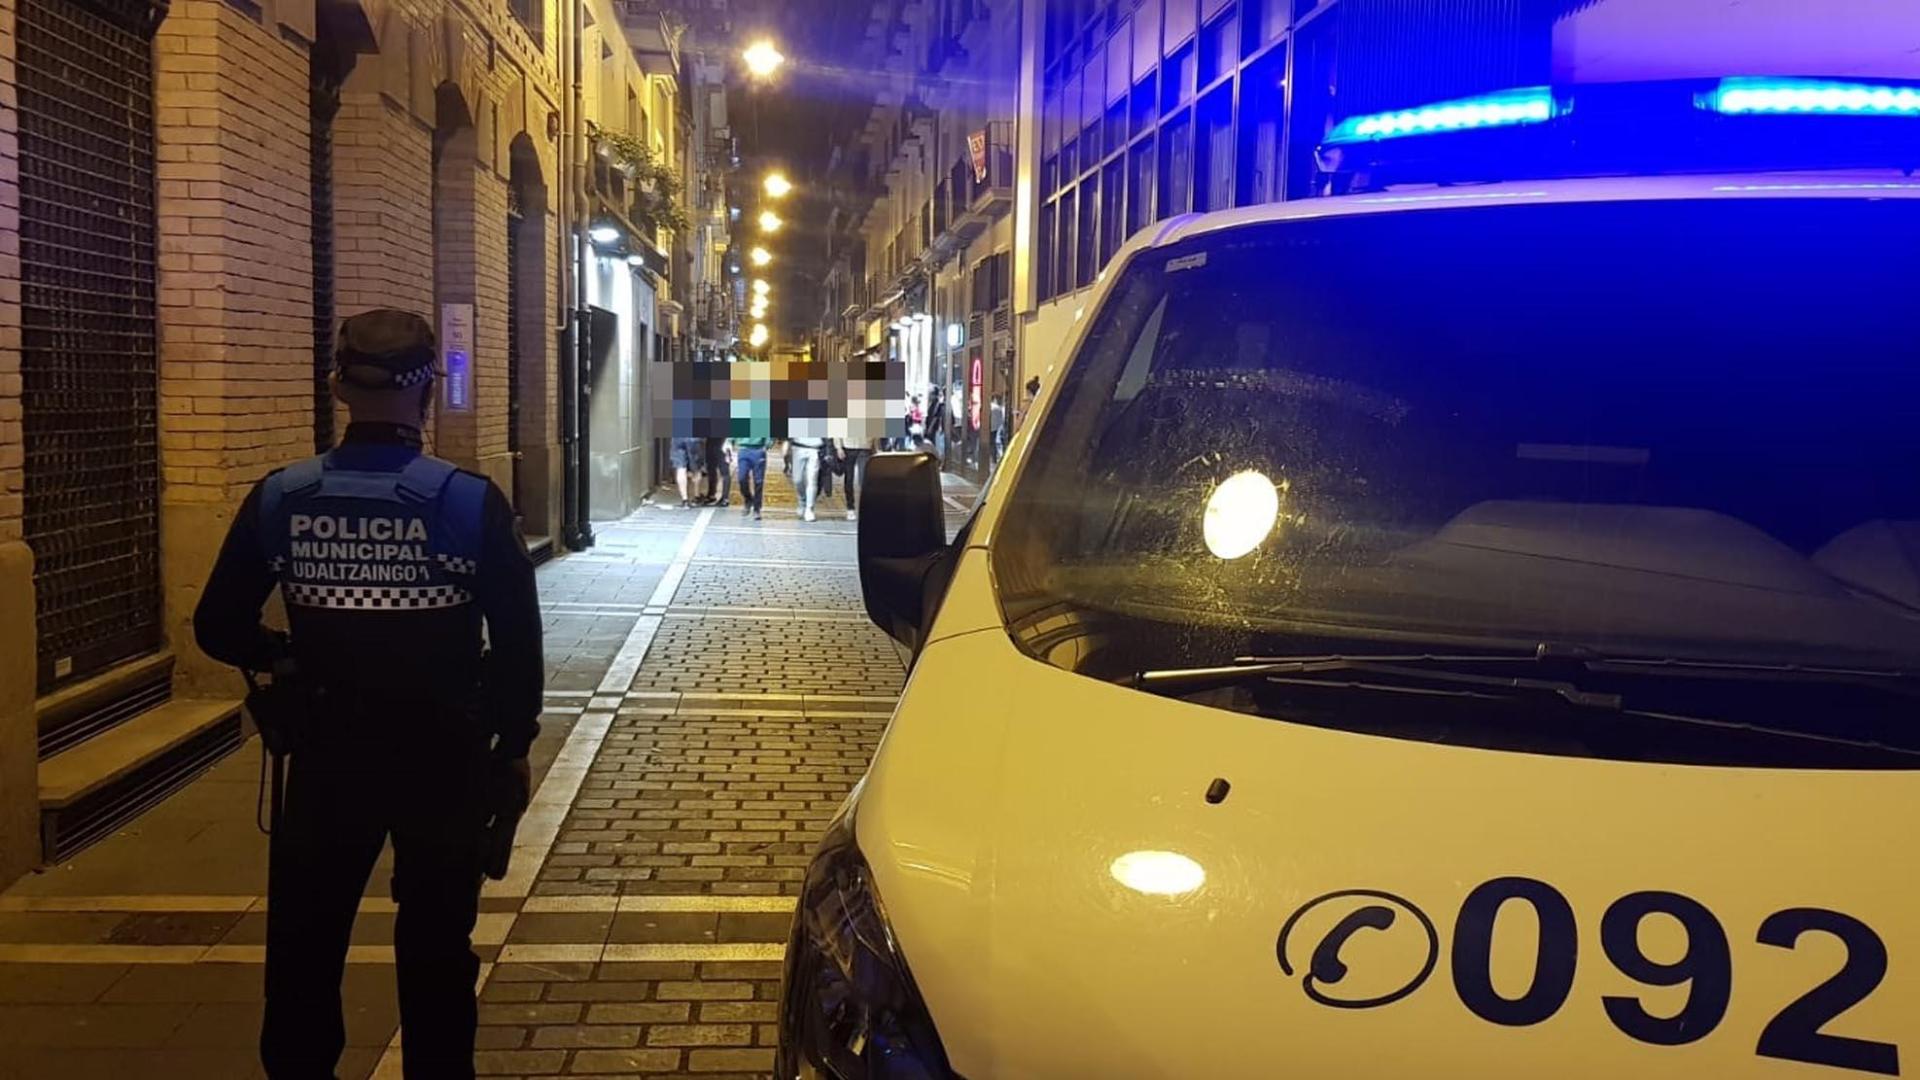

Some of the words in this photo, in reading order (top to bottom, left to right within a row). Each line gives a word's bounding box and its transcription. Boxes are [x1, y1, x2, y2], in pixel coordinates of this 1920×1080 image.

[291, 515, 427, 541] POLICIA
[292, 541, 429, 561] MUNICIPAL
[1451, 876, 1900, 1077] 092
